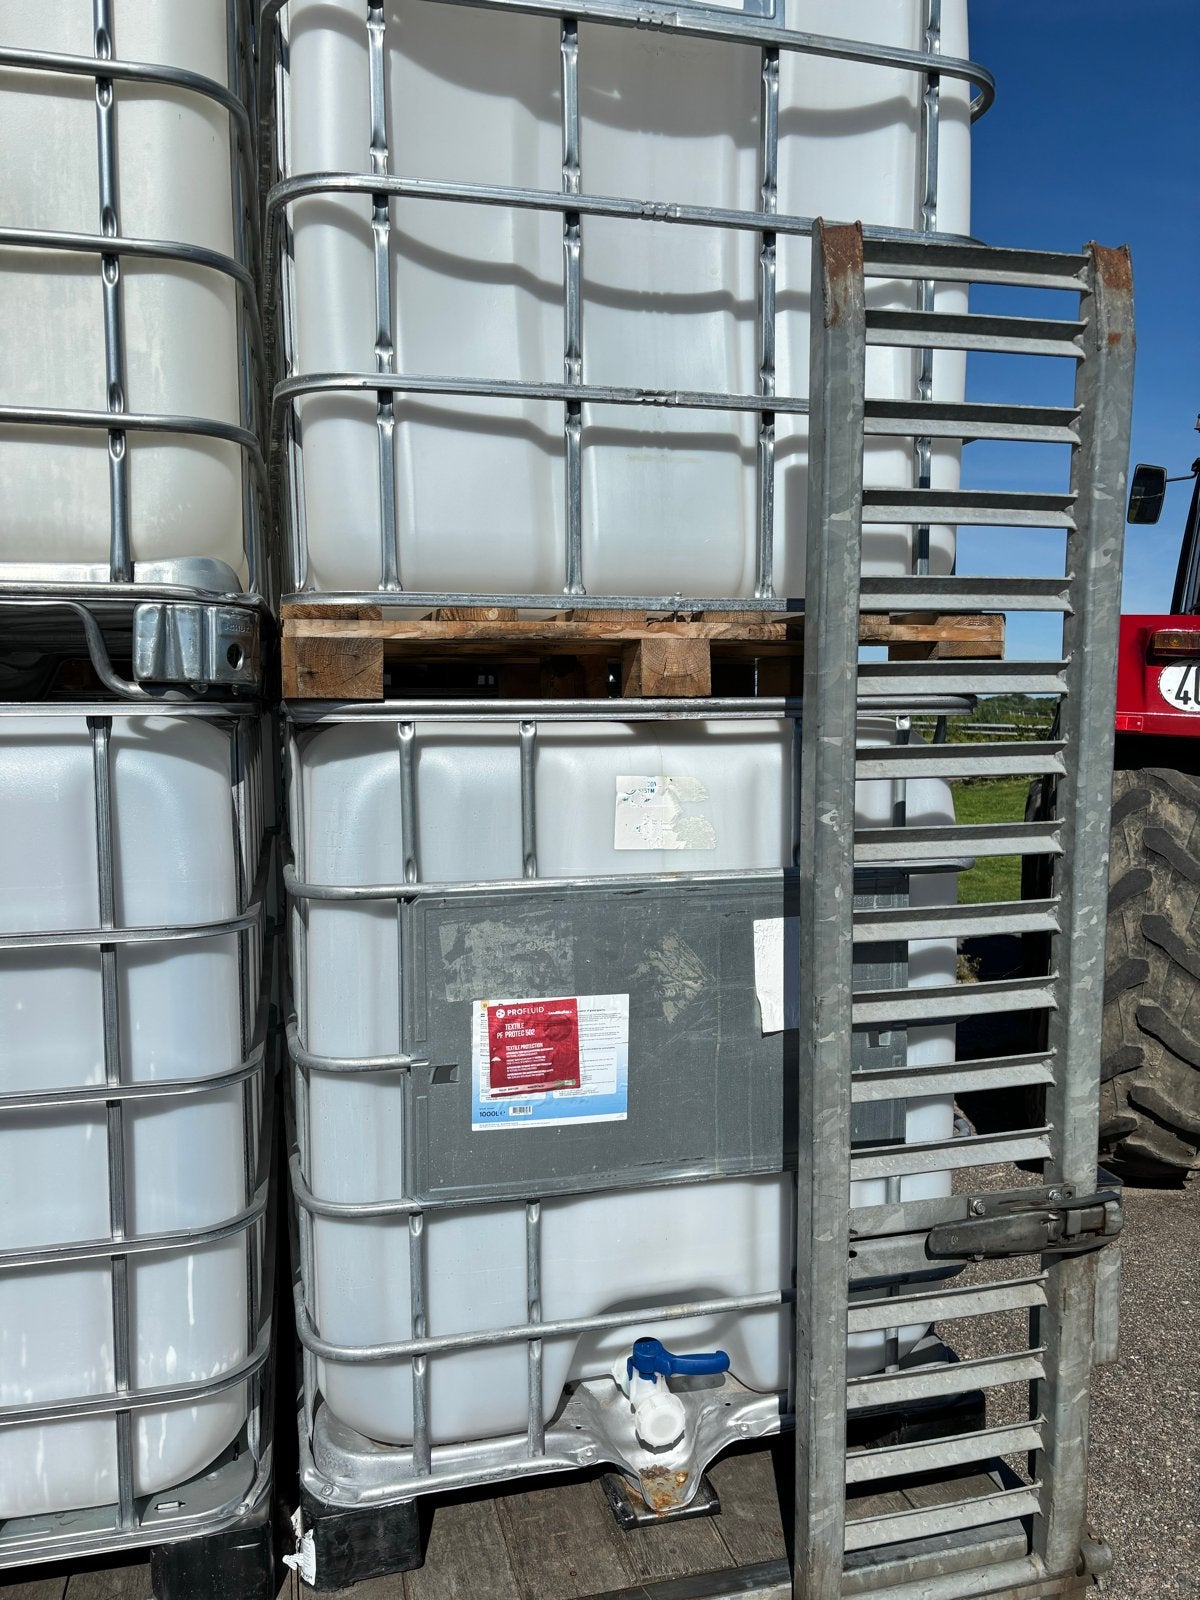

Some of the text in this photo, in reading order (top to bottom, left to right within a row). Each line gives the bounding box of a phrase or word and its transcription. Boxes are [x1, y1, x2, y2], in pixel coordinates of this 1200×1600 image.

[507, 1006, 545, 1016] PROFLUID
[505, 1022, 525, 1031] TEXTILE
[496, 1031, 504, 1039] PF
[504, 1030, 525, 1038] PROTEC
[520, 1042, 544, 1050] PROTECTION
[479, 1110, 499, 1118] 1000L
